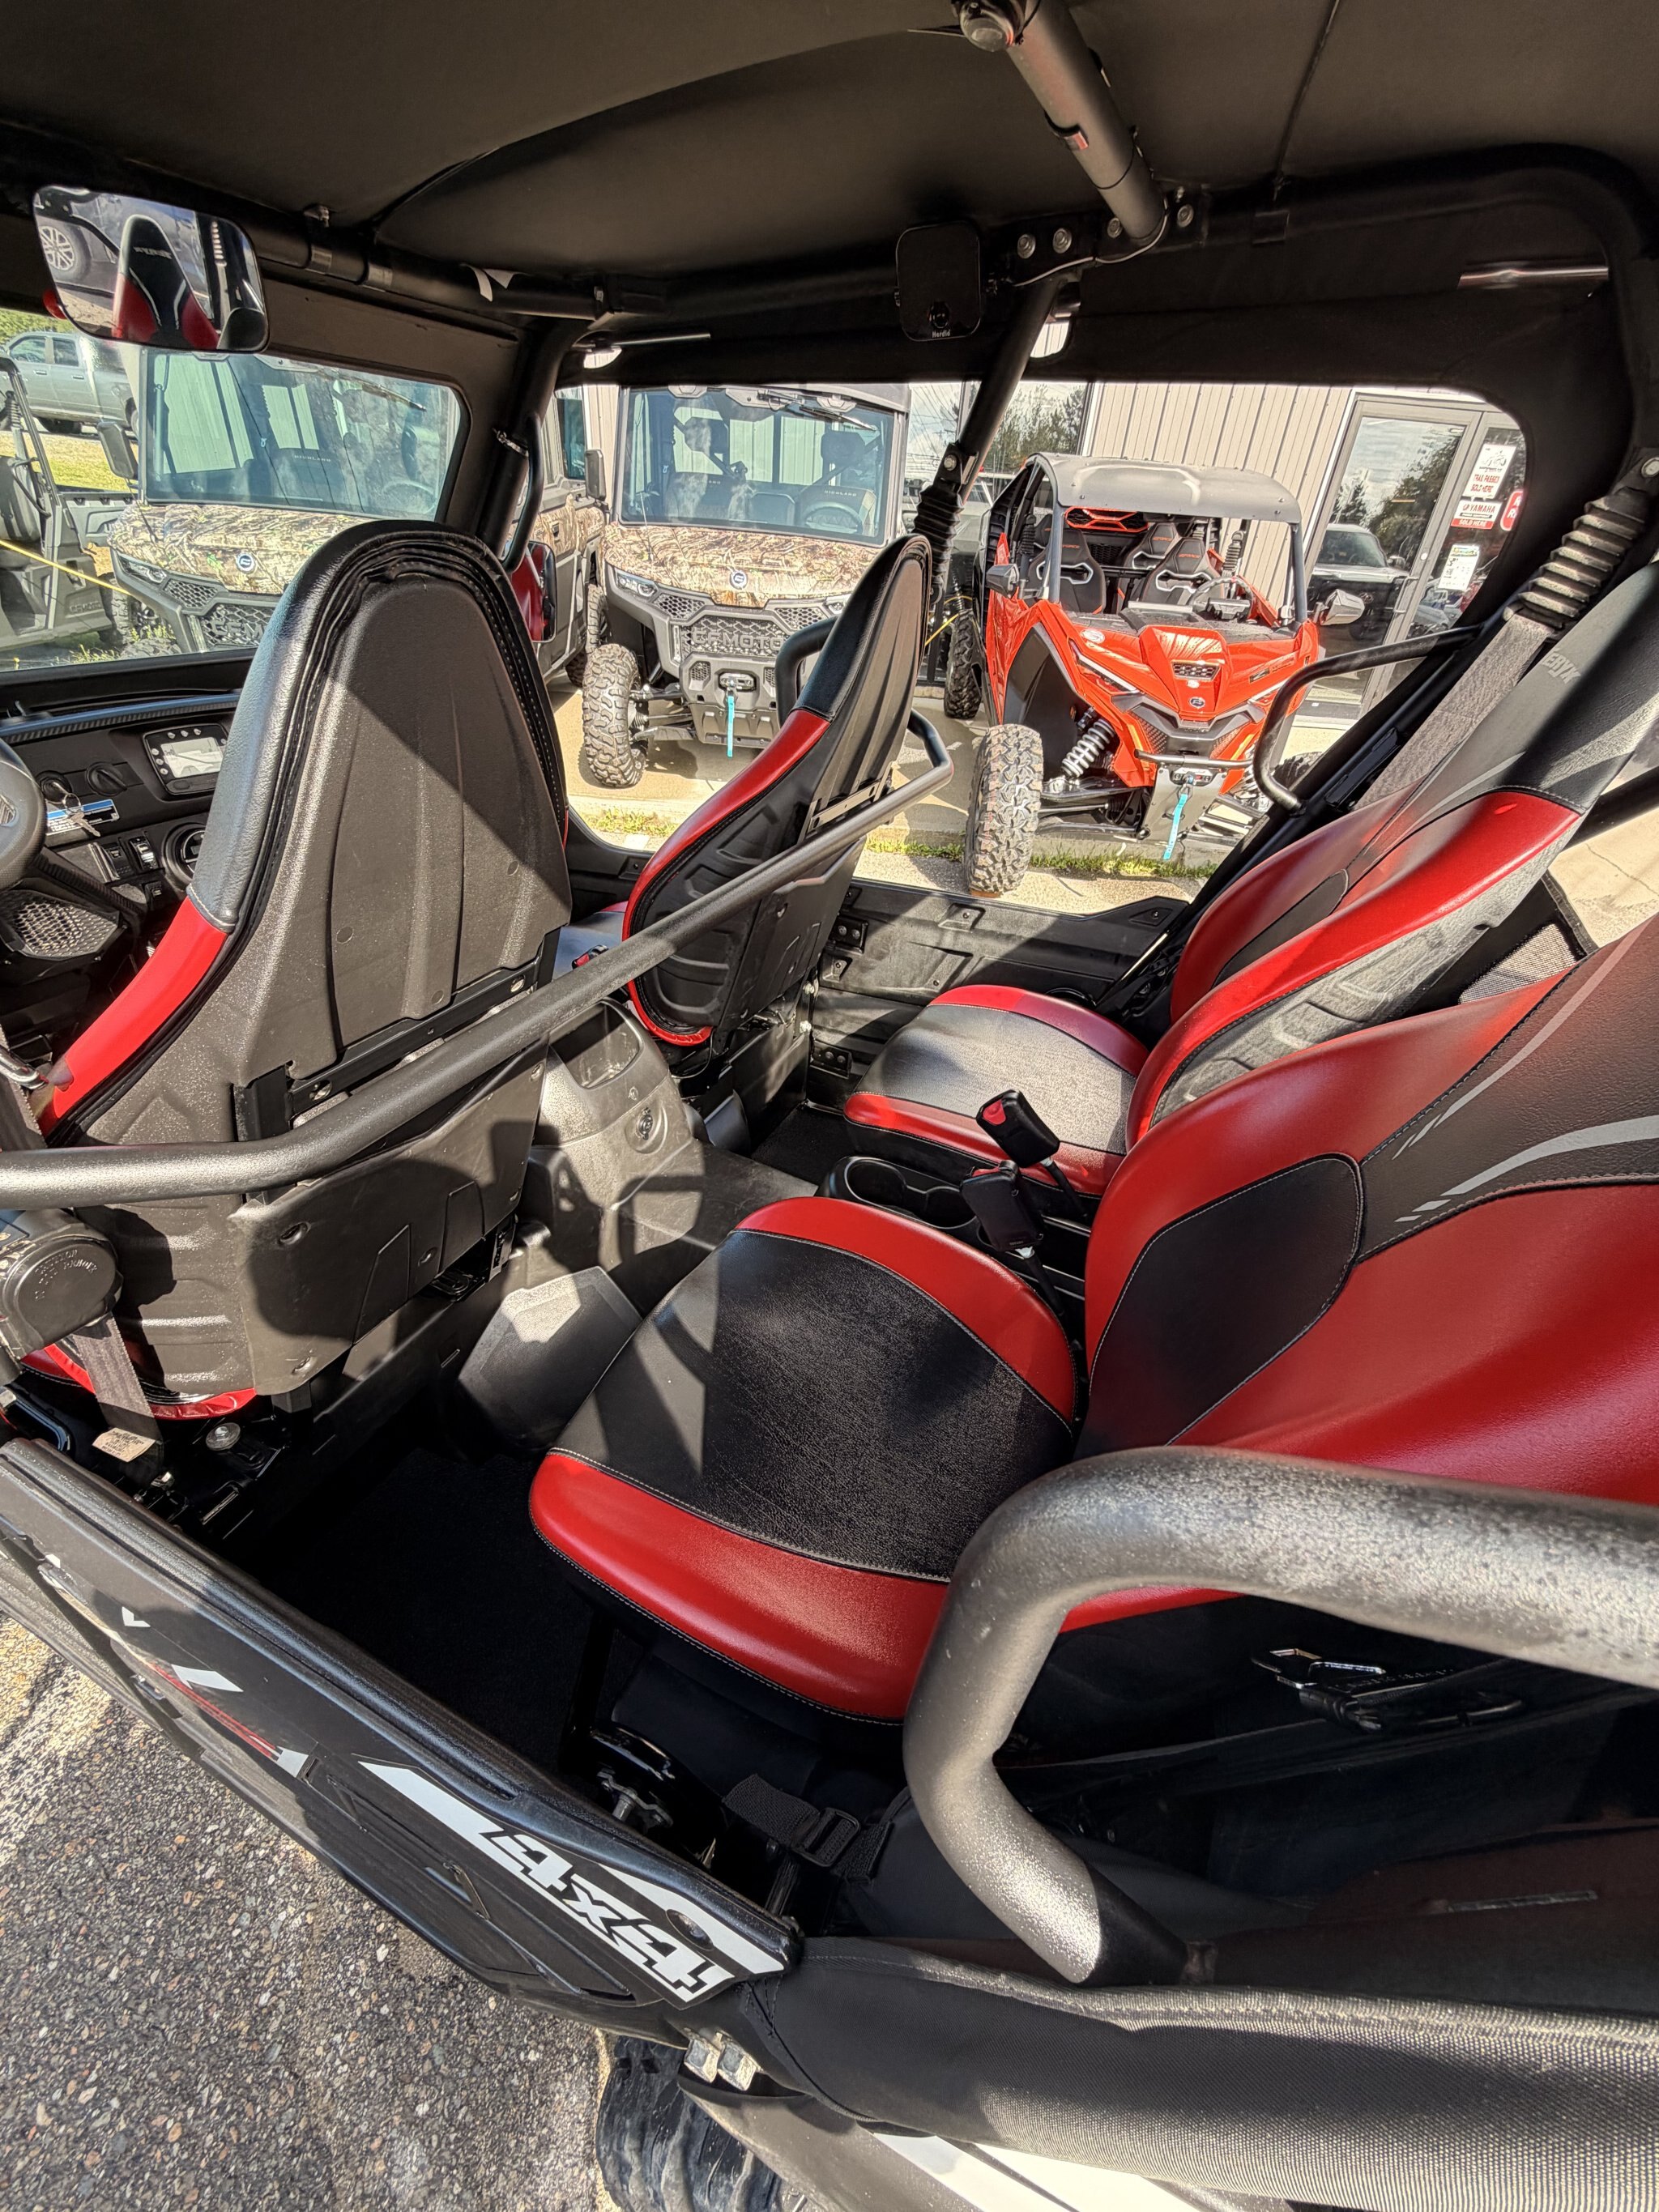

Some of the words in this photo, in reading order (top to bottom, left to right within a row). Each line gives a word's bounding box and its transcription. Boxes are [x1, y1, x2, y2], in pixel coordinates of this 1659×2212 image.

[932, 330, 951, 339] Herdio
[1469, 504, 1496, 514] YAMAHA
[693, 629, 783, 650] CFMOTO
[1542, 648, 1581, 684] ERYX
[490, 1834, 717, 1989] 4x4
